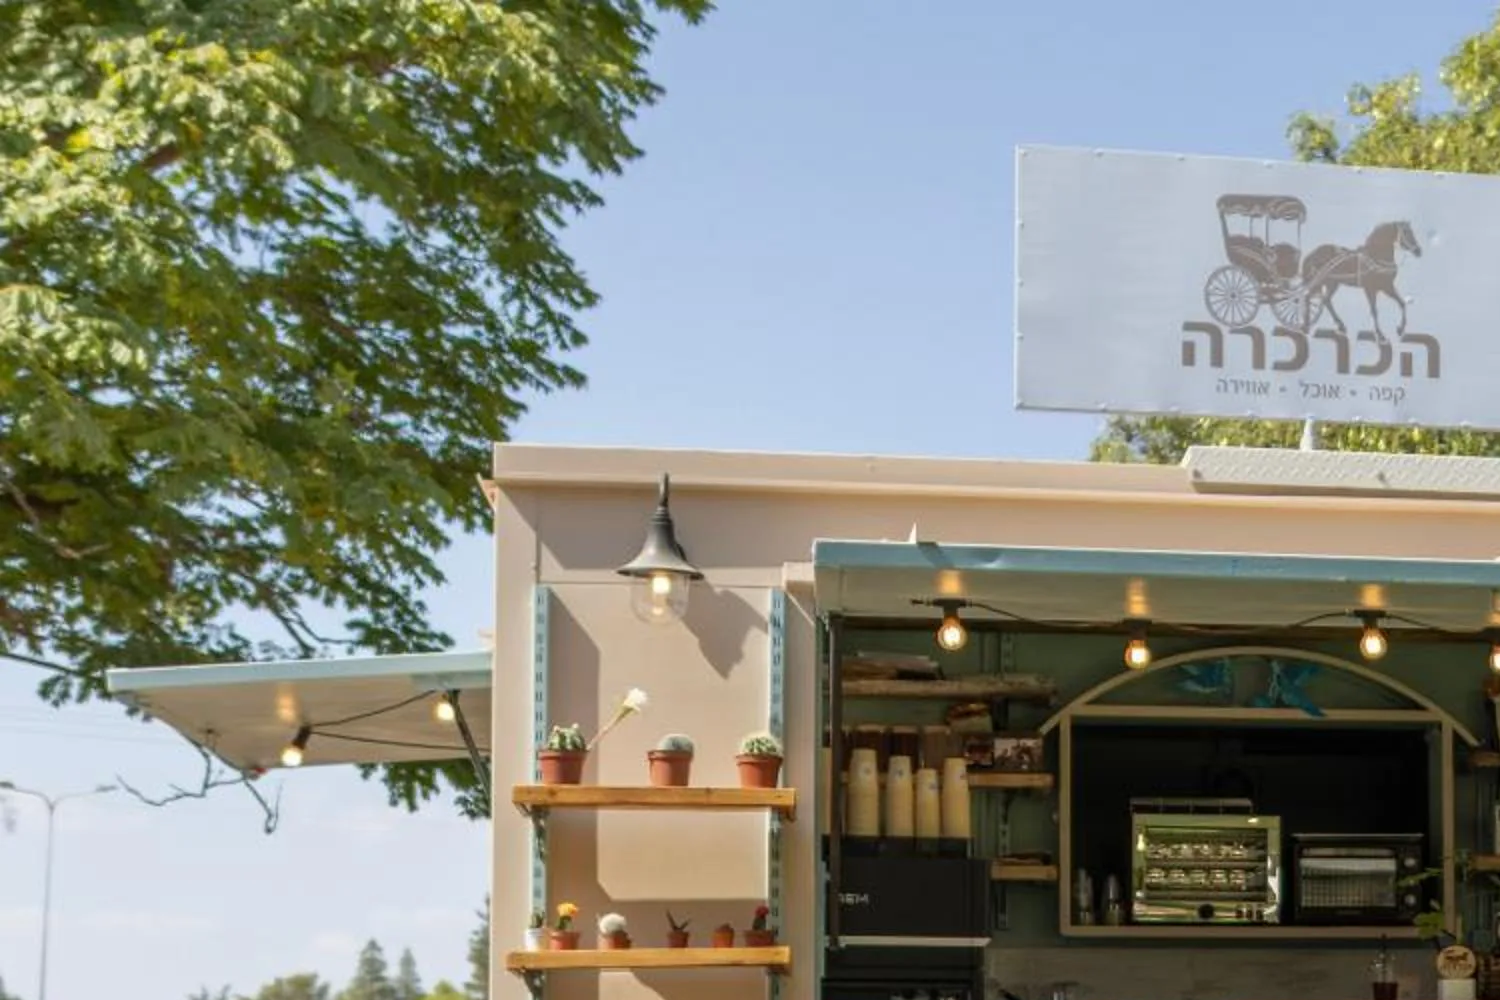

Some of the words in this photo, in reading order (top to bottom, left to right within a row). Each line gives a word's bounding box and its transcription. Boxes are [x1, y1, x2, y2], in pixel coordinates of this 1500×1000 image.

[1182, 321, 1441, 379] הכרכרה
[1215, 378, 1271, 394] אווירה
[1300, 379, 1341, 400] אוכל
[1369, 385, 1406, 407] קפה
